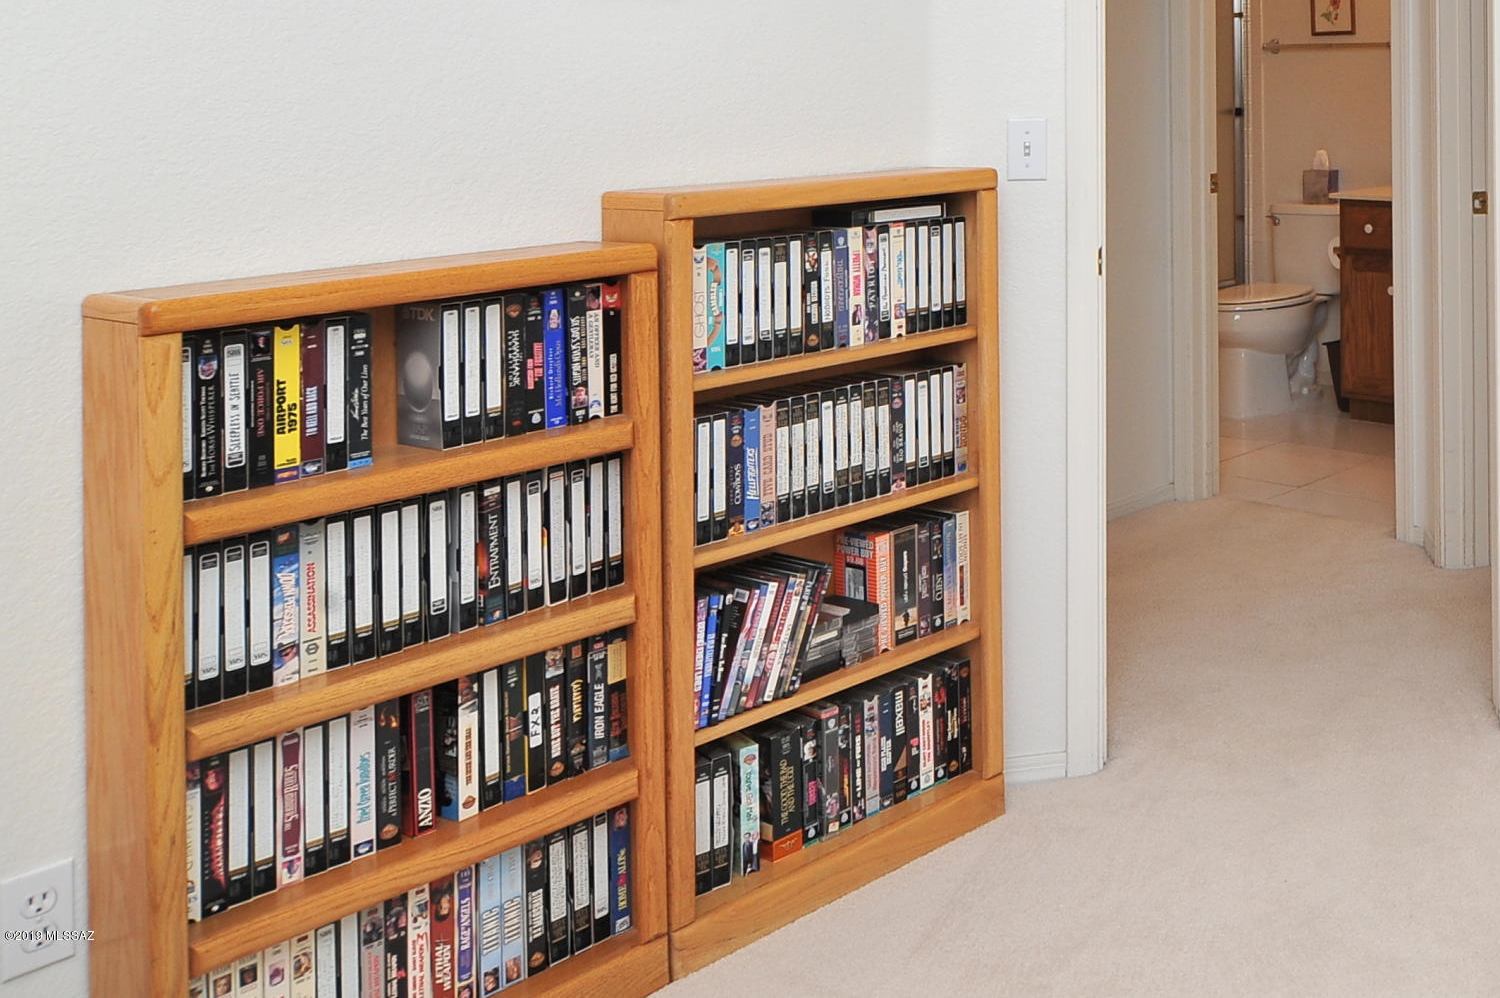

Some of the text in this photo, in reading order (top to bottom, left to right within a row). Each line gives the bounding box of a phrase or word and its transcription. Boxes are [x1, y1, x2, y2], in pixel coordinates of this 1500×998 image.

[853, 253, 861, 296] PRETTY WOMAN
[867, 259, 876, 309] PATRIOT
[410, 308, 435, 322] TDK
[694, 291, 705, 338] GHOST
[229, 372, 241, 401] SEATTLE
[276, 379, 286, 435] AIRPORT
[229, 414, 241, 451] SLEEPLESS
[287, 403, 297, 433] 1975
[746, 447, 758, 500] HELLFIGHTERS
[488, 513, 500, 589] ENTRAPMENT
[306, 563, 317, 633] ASSASSINATION
[935, 573, 943, 601] CLIENT
[549, 685, 561, 758] NONE BUT THE BRAVE
[594, 683, 604, 739] IRON EAGLE
[895, 691, 905, 736] maxell
[418, 788, 432, 827] ANZIO
[460, 897, 472, 950] RAGE ANGELS
[481, 906, 500, 955] TITANIC
[504, 897, 521, 943] TITANIC
[435, 944, 444, 984] LETHAL
[442, 943, 451, 991] WEAPON
